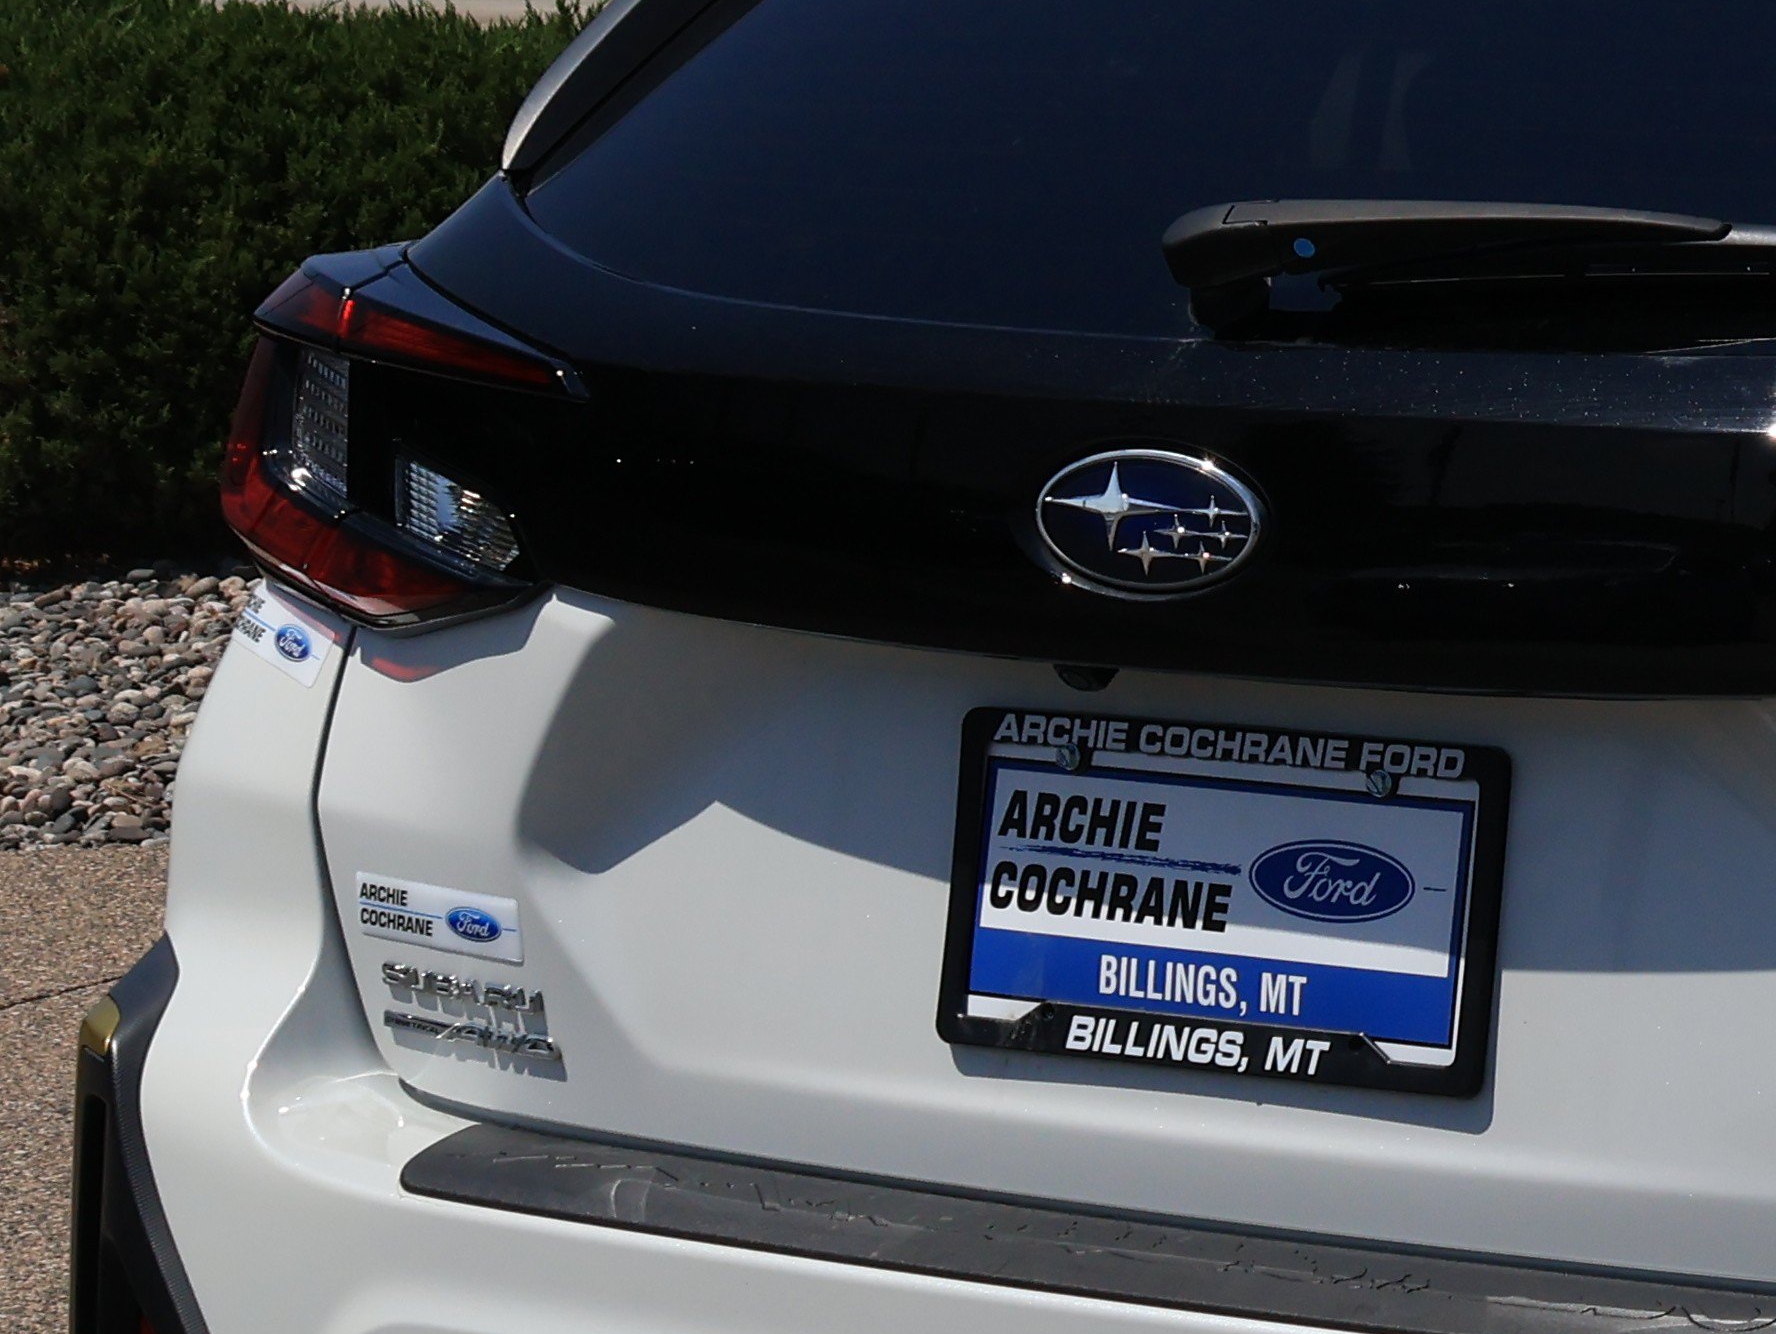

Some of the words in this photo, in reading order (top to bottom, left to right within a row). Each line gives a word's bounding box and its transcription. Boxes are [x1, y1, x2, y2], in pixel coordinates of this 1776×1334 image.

[994, 714, 1129, 751] ARCHIE
[1139, 724, 1348, 769] COCHRANE
[1359, 742, 1465, 779] FORD
[998, 789, 1166, 852] ARCHIE
[359, 882, 409, 907] ARCHIE
[989, 861, 1232, 933] COCHRANE
[1283, 851, 1379, 908] Ford
[360, 907, 434, 937] COCHRANE
[456, 912, 490, 937] Ford
[1099, 954, 1247, 1017] BILLINGS,
[1260, 973, 1308, 1017] MT
[1065, 1015, 1249, 1072] BILLINGS,
[1264, 1036, 1330, 1075] MT
